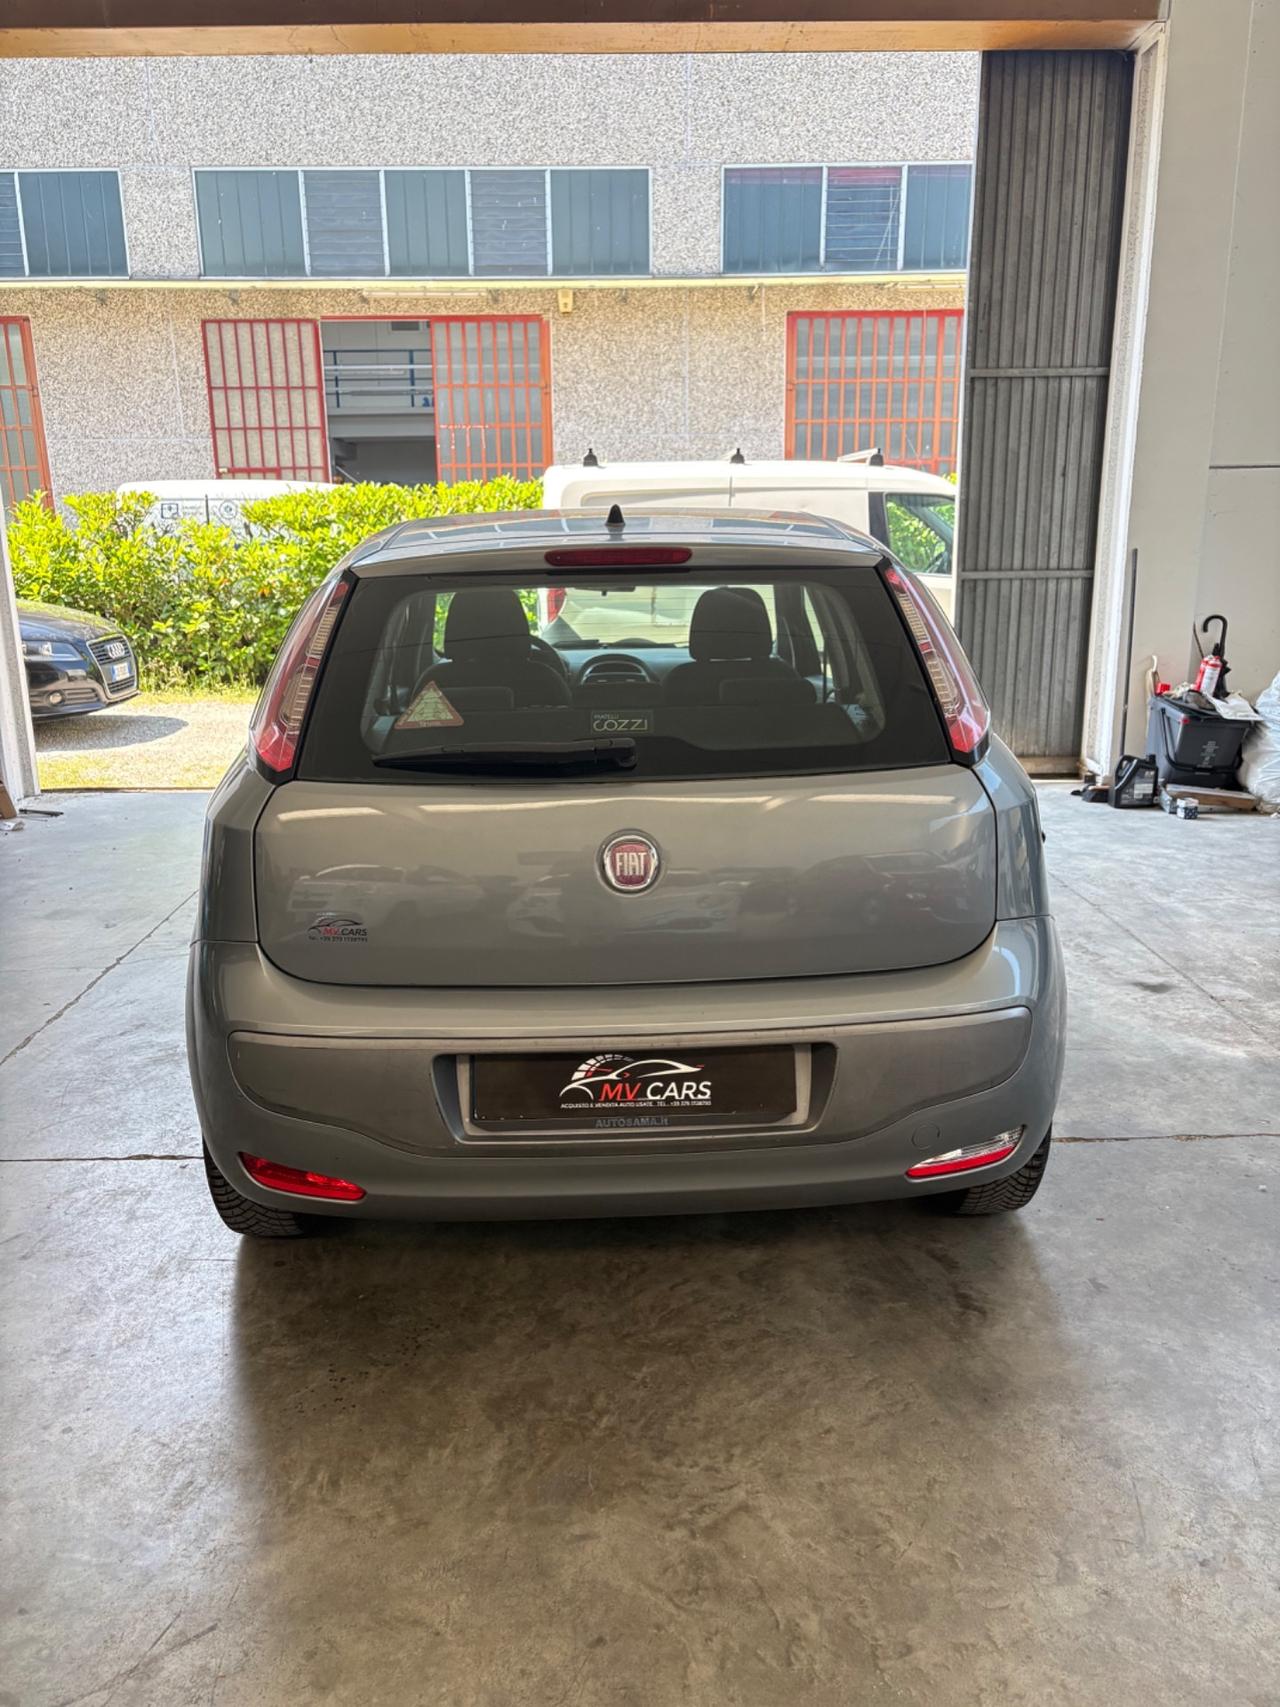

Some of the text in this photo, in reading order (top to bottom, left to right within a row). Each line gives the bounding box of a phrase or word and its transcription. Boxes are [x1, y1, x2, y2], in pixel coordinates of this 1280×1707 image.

[593, 719, 648, 731] COZZI
[615, 851, 647, 877] FIAT
[322, 927, 368, 937] MV CARS
[599, 1081, 712, 1101] MV CARS
